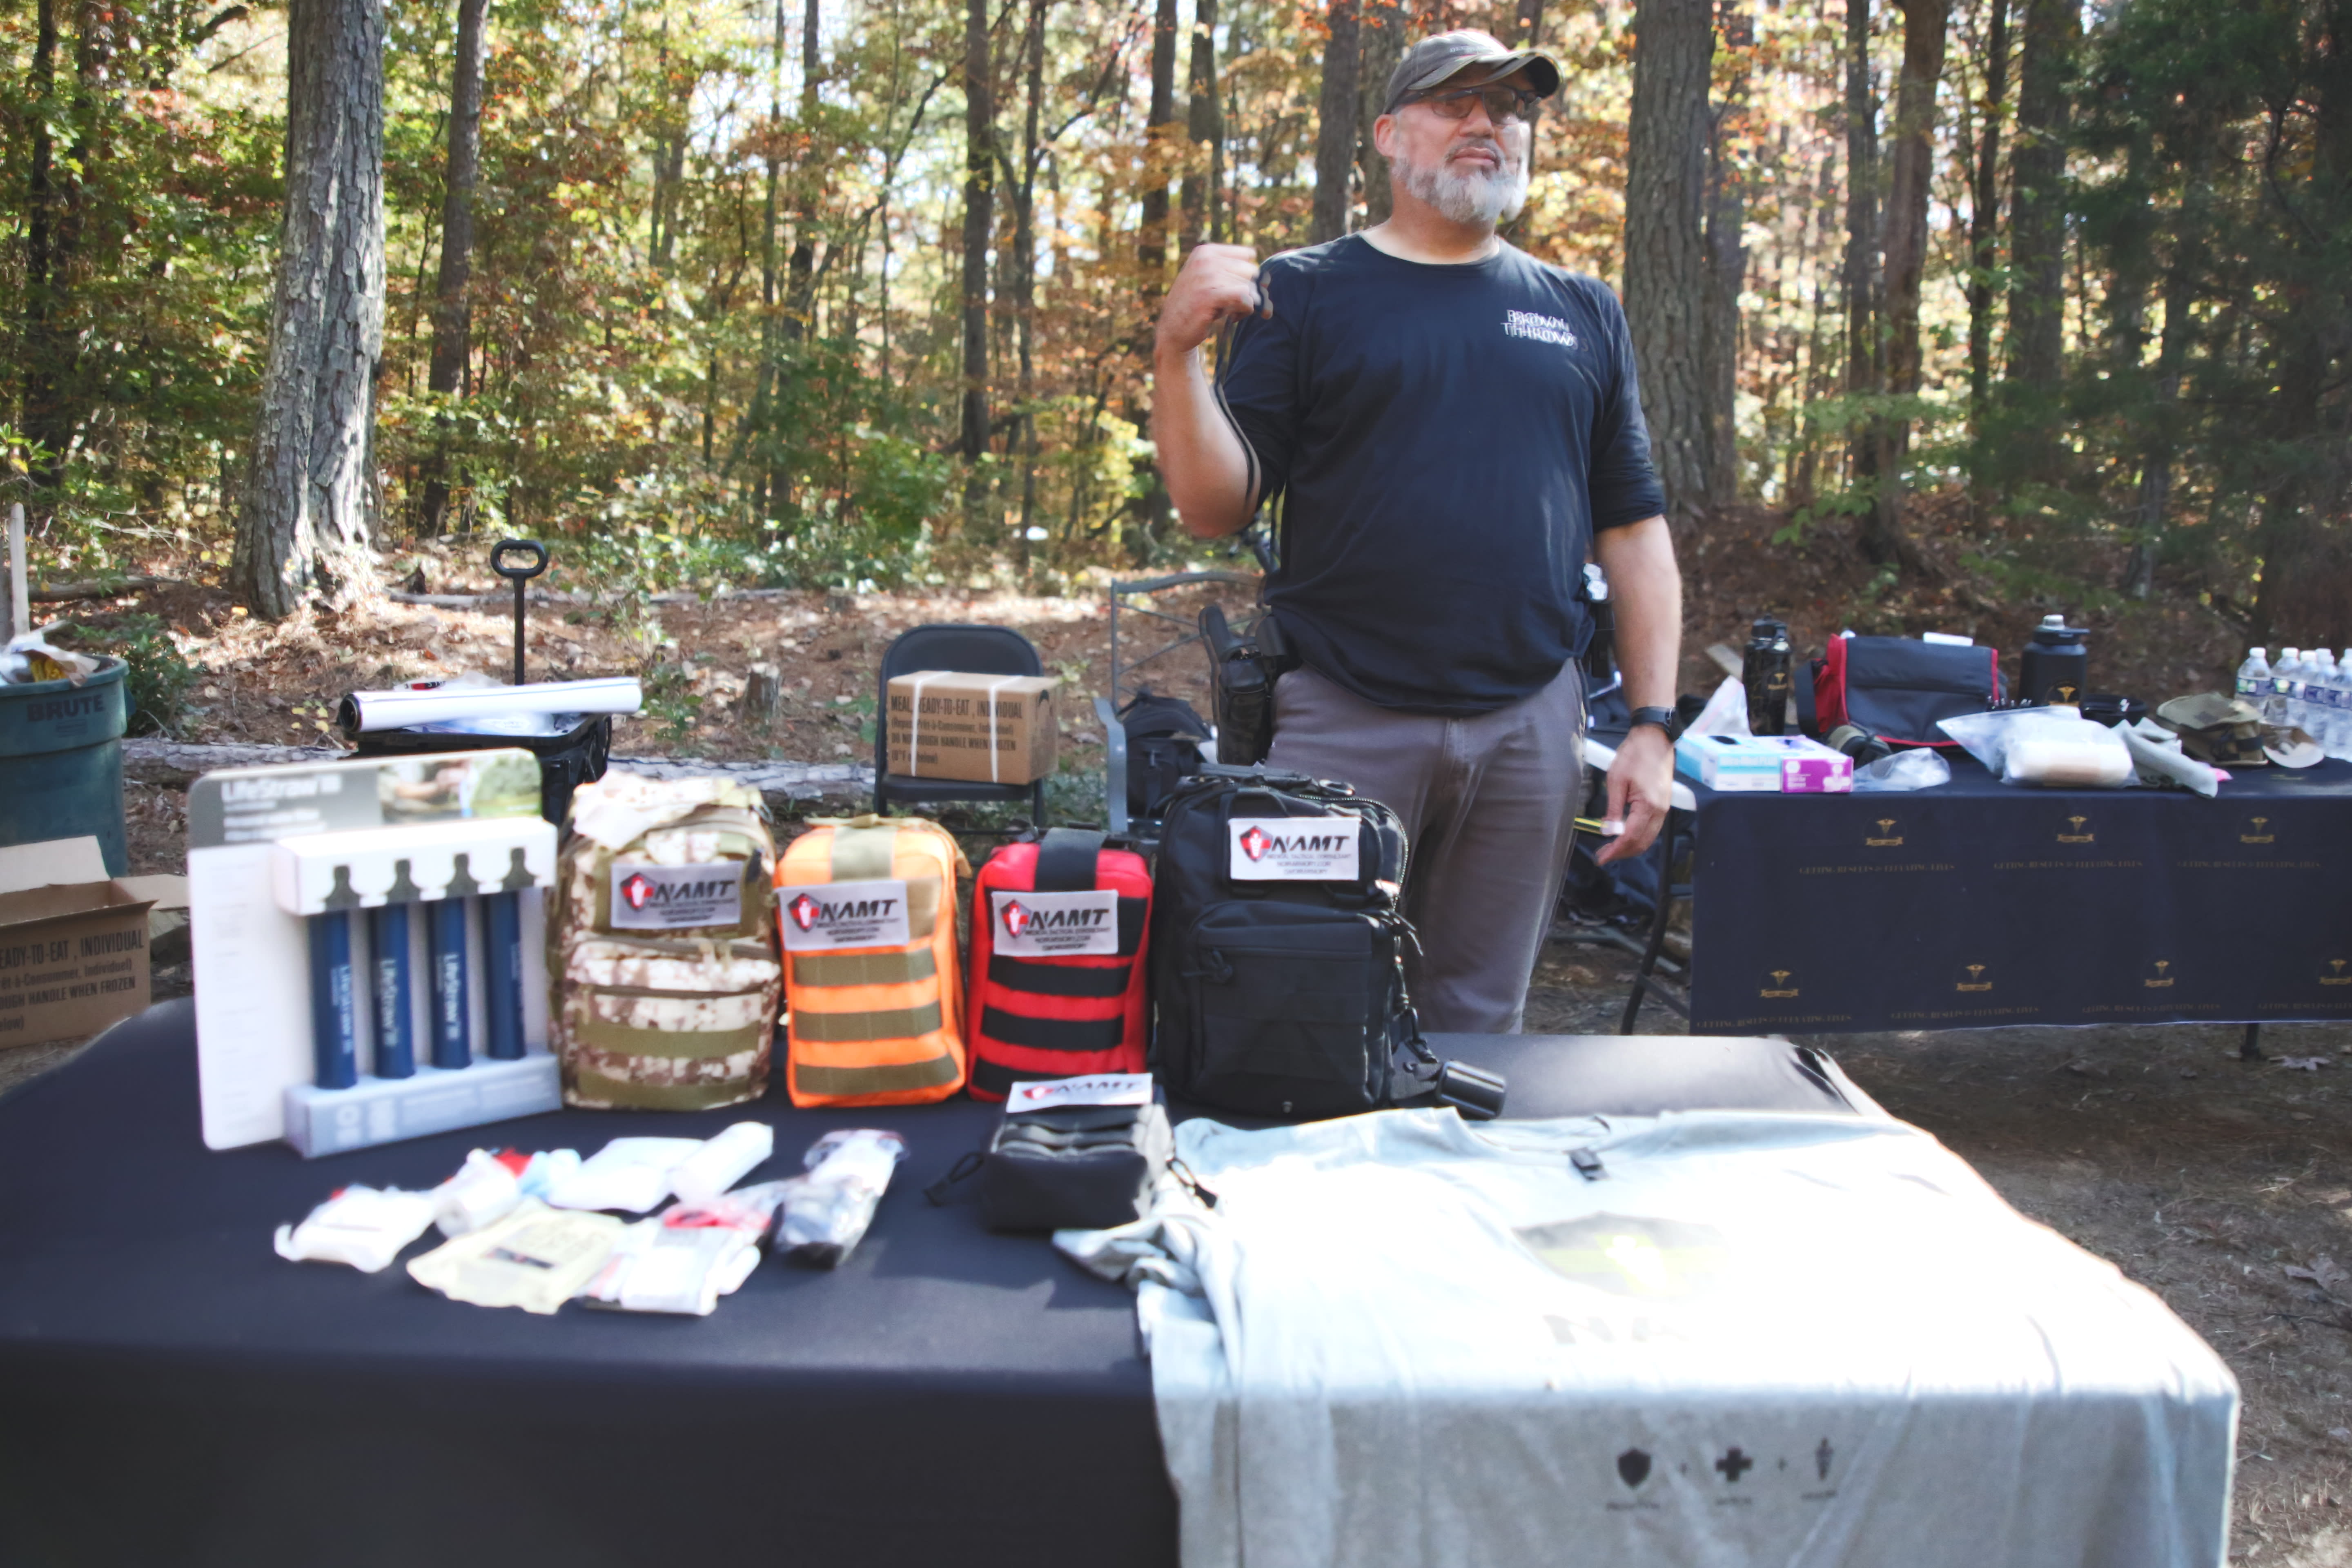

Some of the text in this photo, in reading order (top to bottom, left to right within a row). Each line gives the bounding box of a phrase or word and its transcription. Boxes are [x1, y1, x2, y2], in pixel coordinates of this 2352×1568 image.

[27, 695, 105, 722] BRUTE
[977, 700, 1022, 719] INDVIDUAL
[1272, 835, 1350, 853] NAMT
[655, 880, 736, 902] NAMT
[821, 899, 898, 922] NAMT
[1029, 909, 1109, 930] NAMT
[0, 940, 69, 969] EADY-TO-EAT
[80, 929, 144, 957] INDIVIDUAL
[0, 976, 136, 1010] OUGH HANDLE WHEN FROZEN
[0, 1015, 24, 1031] elow)
